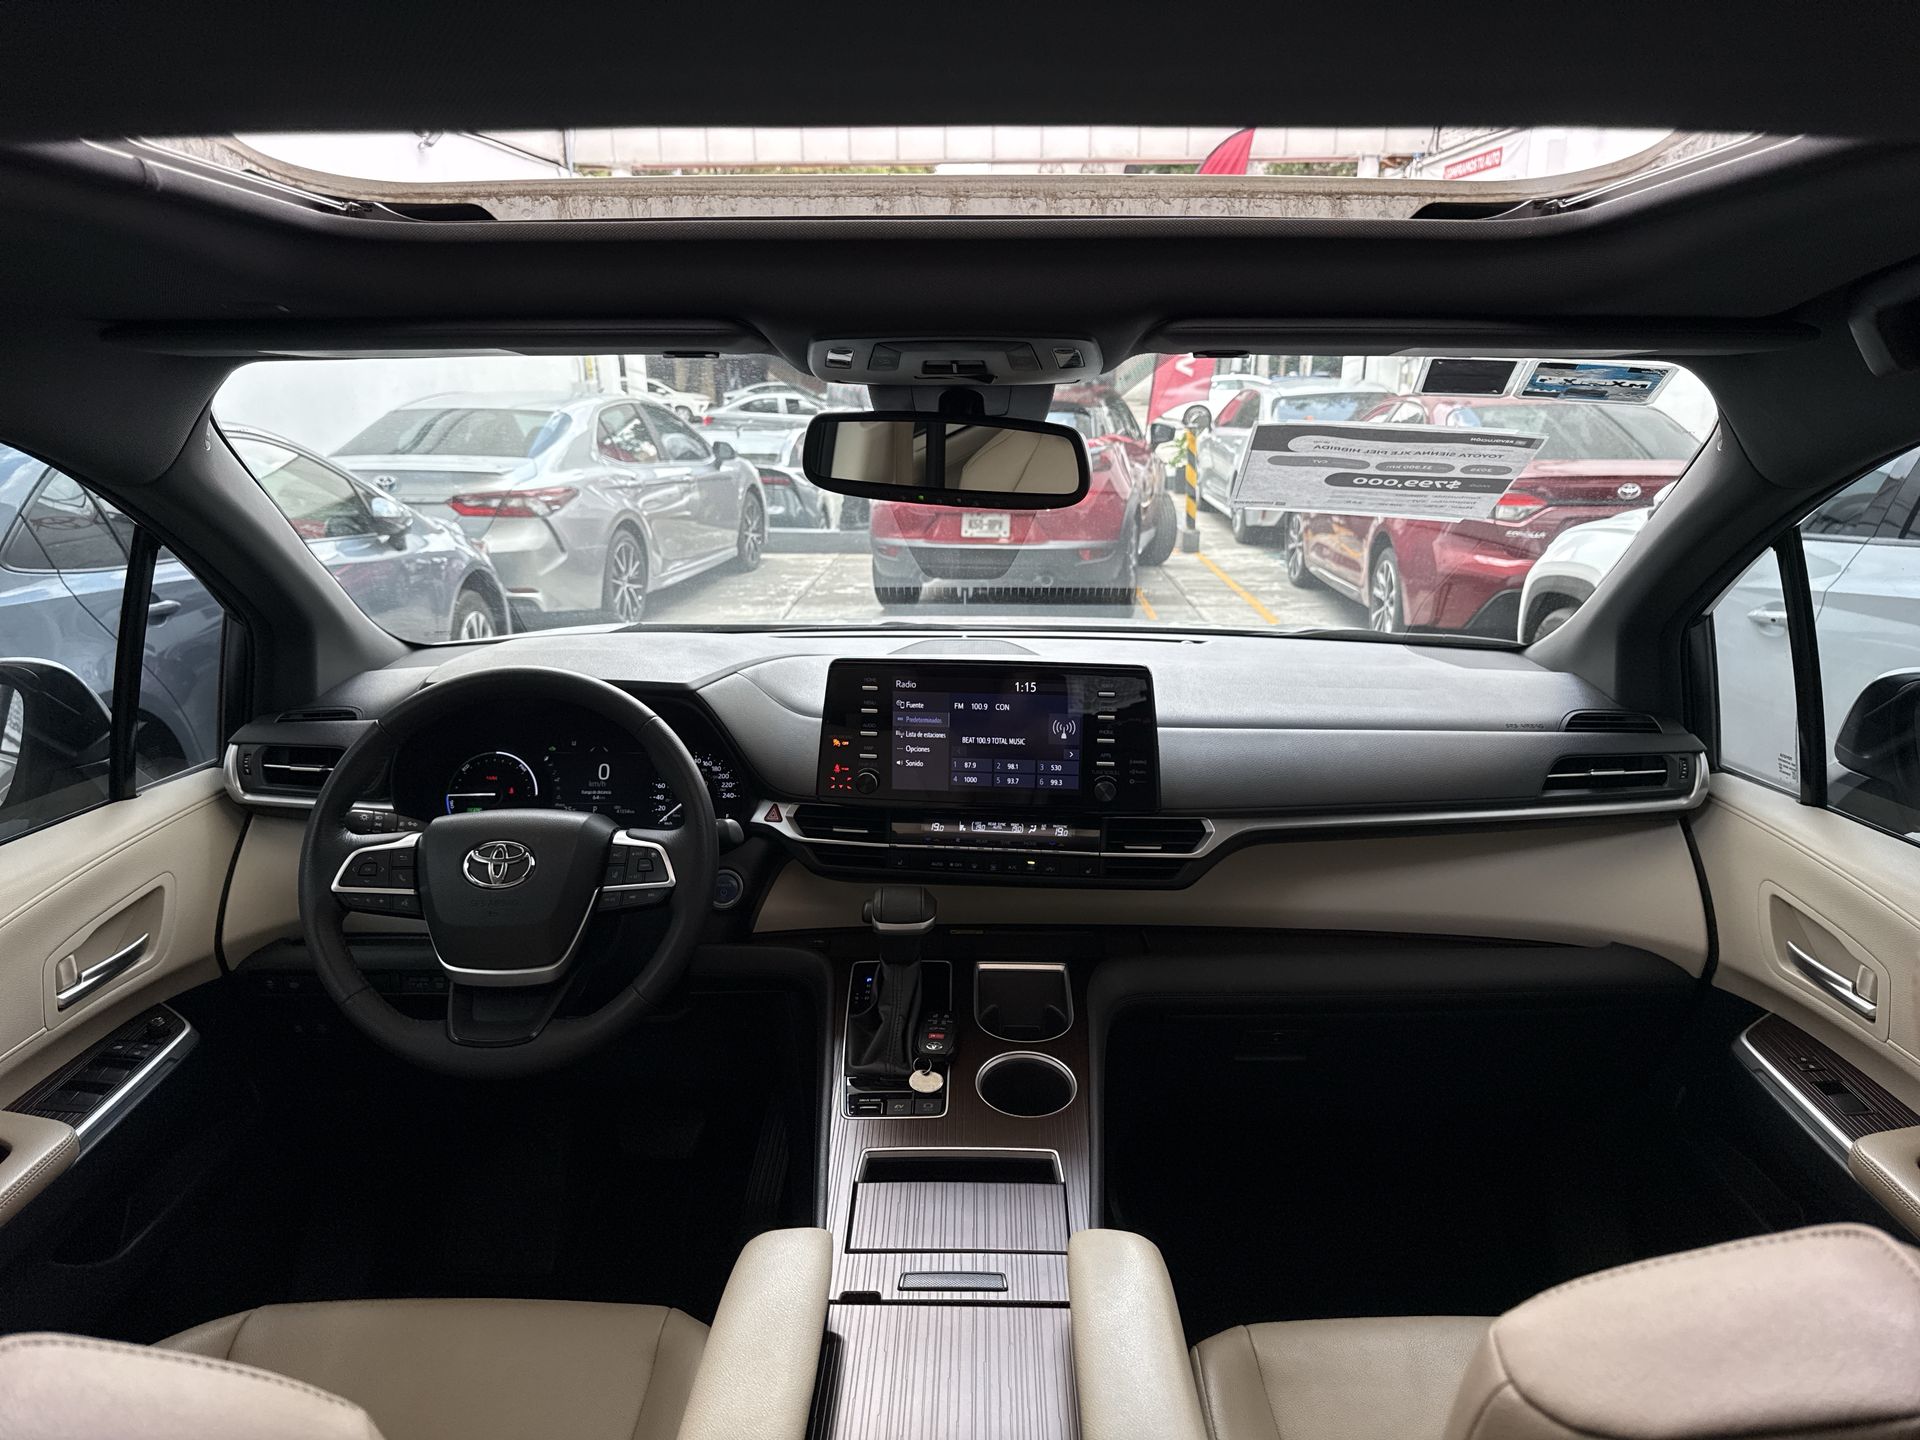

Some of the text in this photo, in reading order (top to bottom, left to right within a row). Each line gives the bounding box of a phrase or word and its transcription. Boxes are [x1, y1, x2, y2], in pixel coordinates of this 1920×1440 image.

[895, 680, 917, 690] Radio
[1014, 681, 1037, 693] 1:15
[954, 702, 1010, 711] FM 100.9 CON
[923, 732, 947, 740] estaciones
[962, 736, 975, 744] BEAT
[976, 737, 991, 745] 100.9
[1009, 738, 1026, 746] MUSIC
[905, 745, 931, 754] Opciones
[905, 760, 924, 768] Sonido
[598, 763, 611, 781] 0
[930, 822, 945, 832] 19.0
[1054, 827, 1069, 837] 19.0
